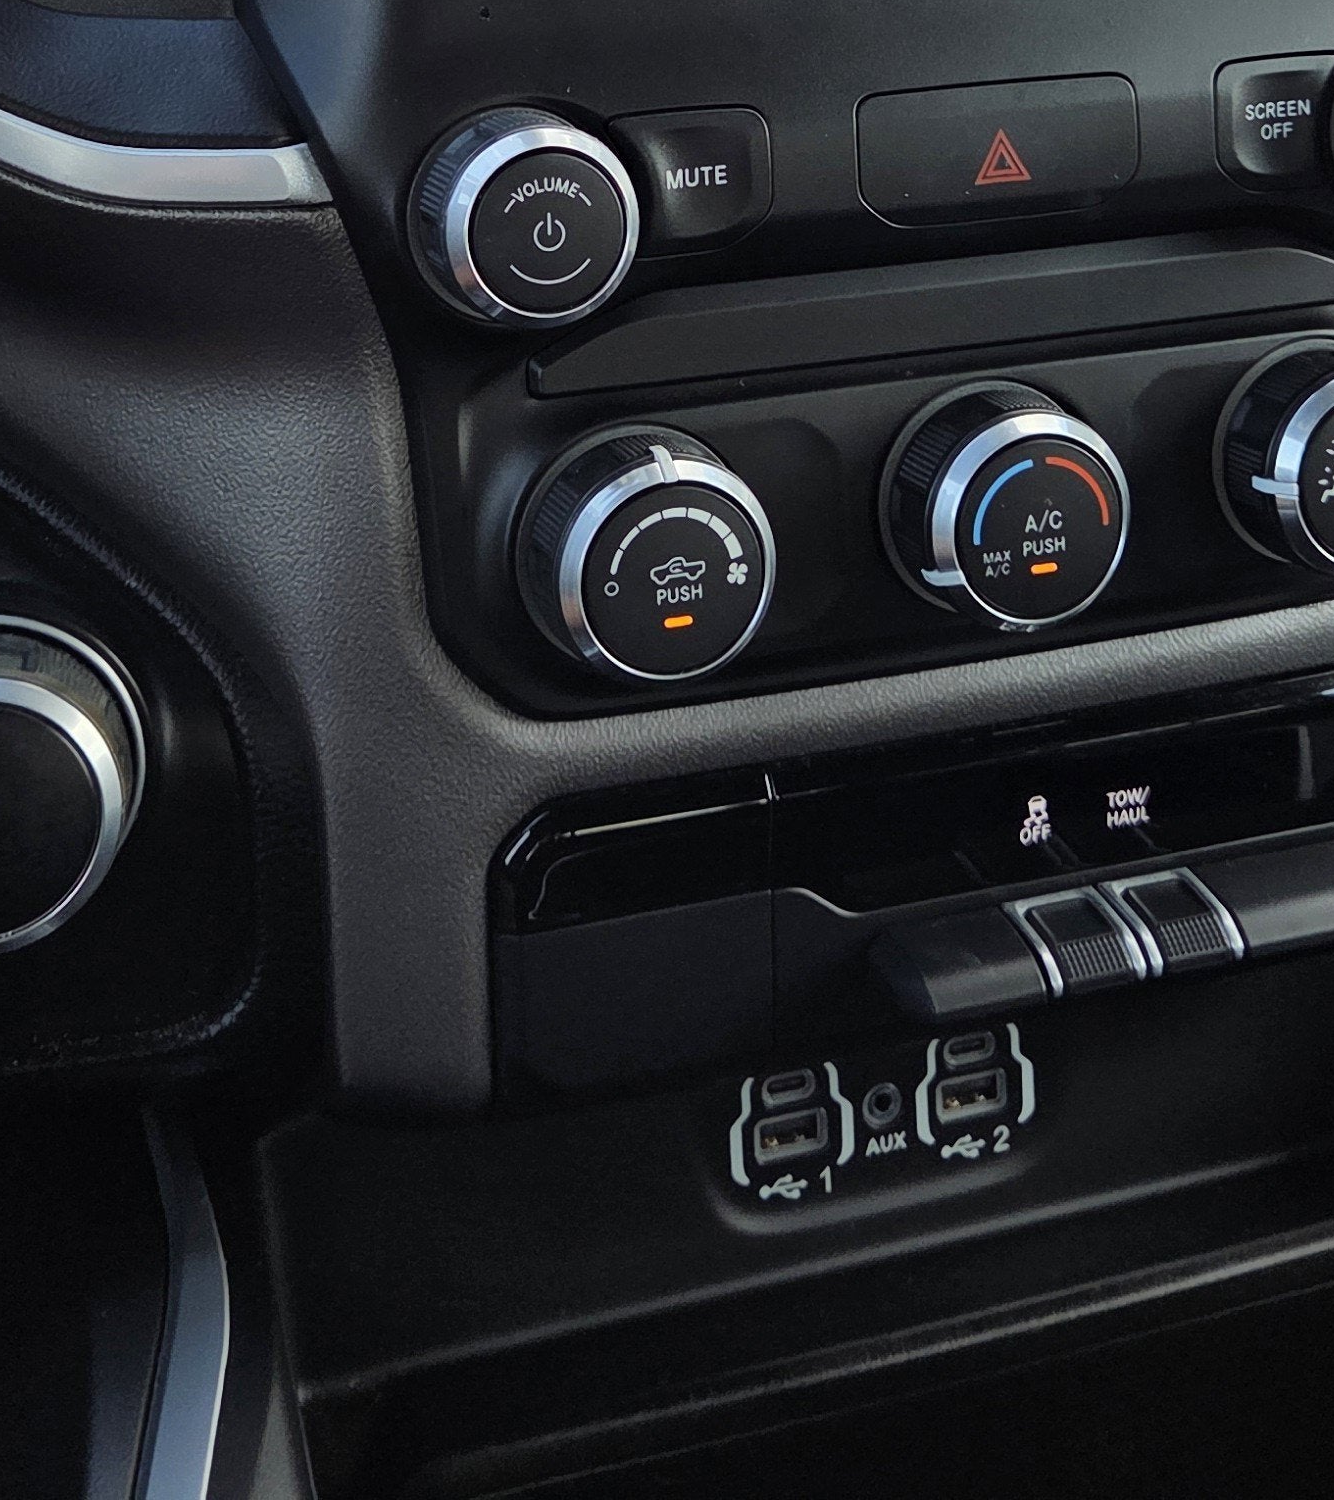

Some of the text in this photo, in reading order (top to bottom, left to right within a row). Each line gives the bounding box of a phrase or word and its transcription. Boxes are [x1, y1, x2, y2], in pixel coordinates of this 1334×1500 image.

[1245, 99, 1312, 121] SCREEN
[1260, 122, 1294, 140] OFF
[666, 165, 727, 190] MUTE
[511, 177, 580, 203] VOLUME
[1025, 510, 1063, 534] A/C
[983, 550, 1012, 564] MAX
[1022, 536, 1066, 557] PUSH
[985, 563, 1010, 577] A/C
[656, 583, 702, 606] PUSH
[1106, 785, 1152, 809] TOW/
[1107, 807, 1150, 829] HAUL
[1019, 823, 1052, 846] OFF
[865, 1130, 907, 1157] AUX
[993, 1125, 1011, 1152] 2
[819, 1165, 832, 1193] 1
